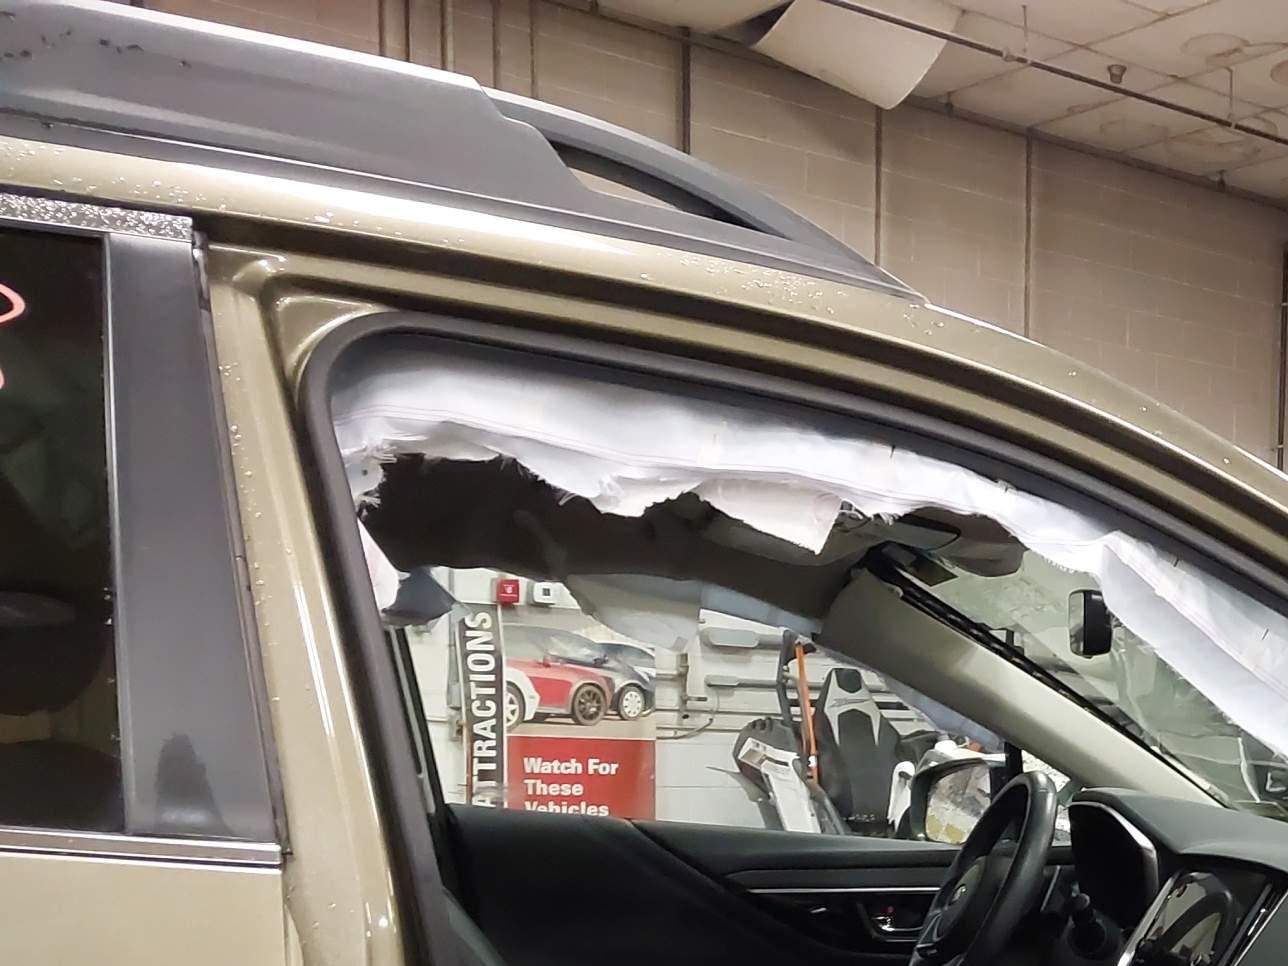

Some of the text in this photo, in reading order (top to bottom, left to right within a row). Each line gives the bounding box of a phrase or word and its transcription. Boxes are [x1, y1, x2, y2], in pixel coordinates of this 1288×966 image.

[465, 611, 497, 808] ATTRACTIONS
[524, 757, 619, 775] Watch For
[524, 779, 584, 796] These
[525, 801, 609, 817] Vehicles
